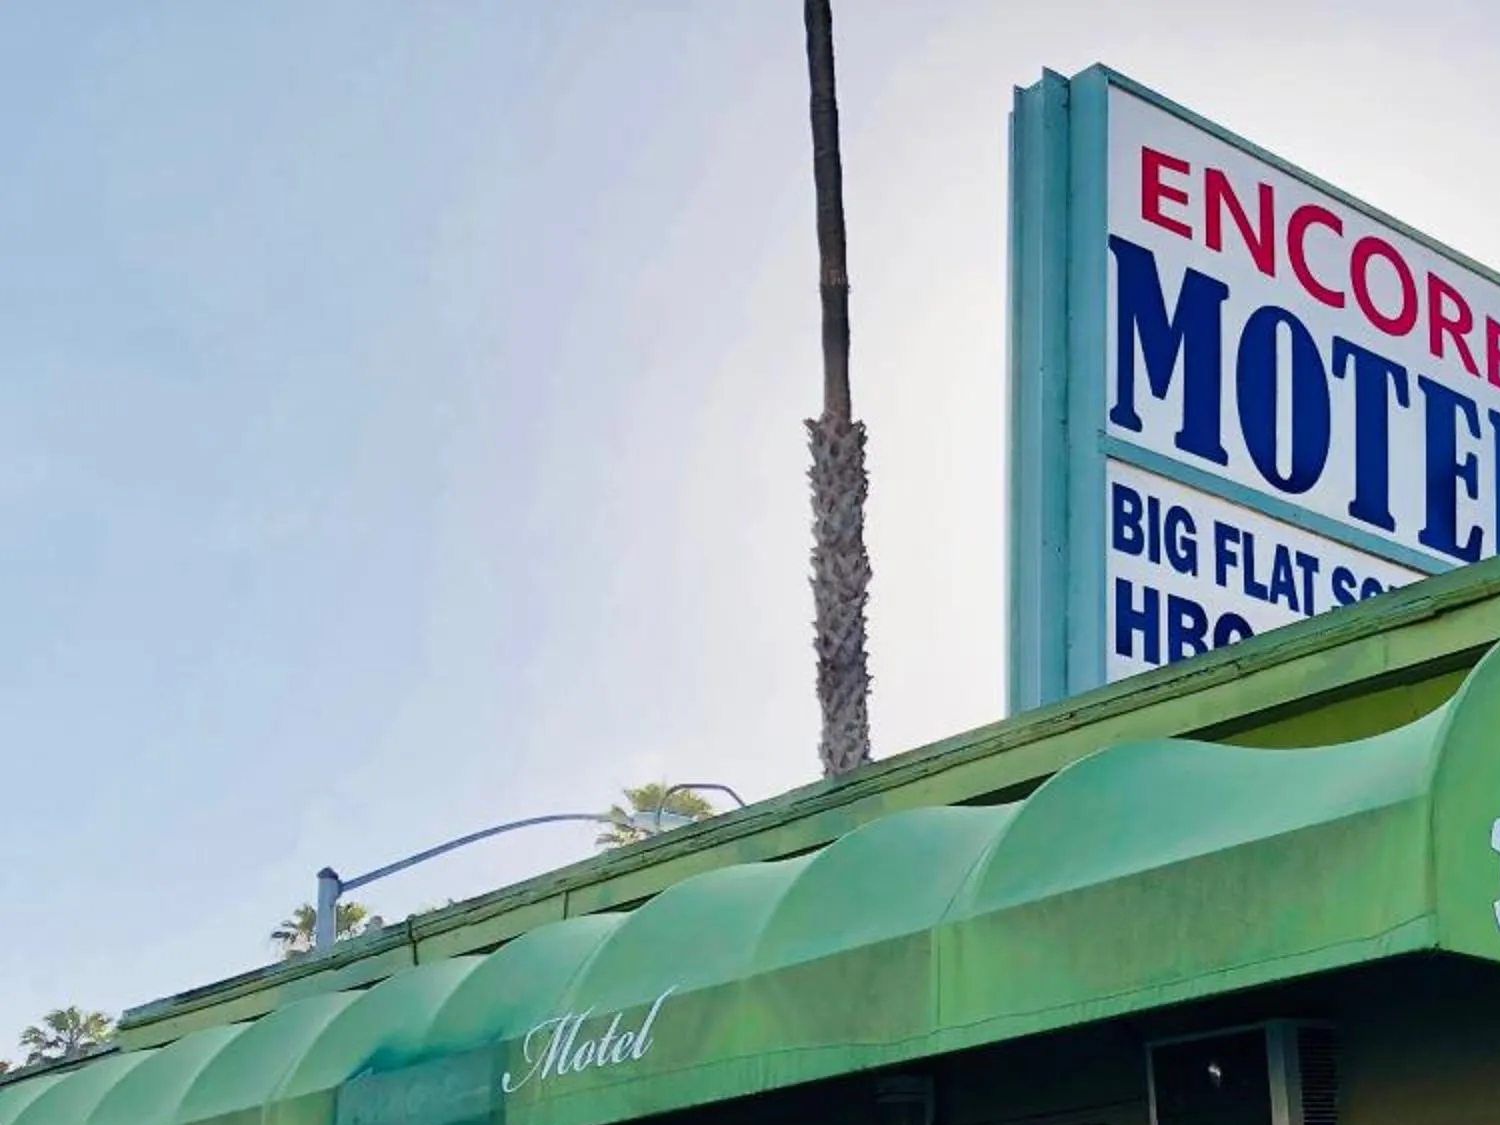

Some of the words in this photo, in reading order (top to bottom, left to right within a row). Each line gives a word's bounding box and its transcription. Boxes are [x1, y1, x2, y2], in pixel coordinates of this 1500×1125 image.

[1112, 481, 1198, 577] BIG
[1213, 520, 1320, 616] FLAT
[502, 985, 679, 1093] Motel
